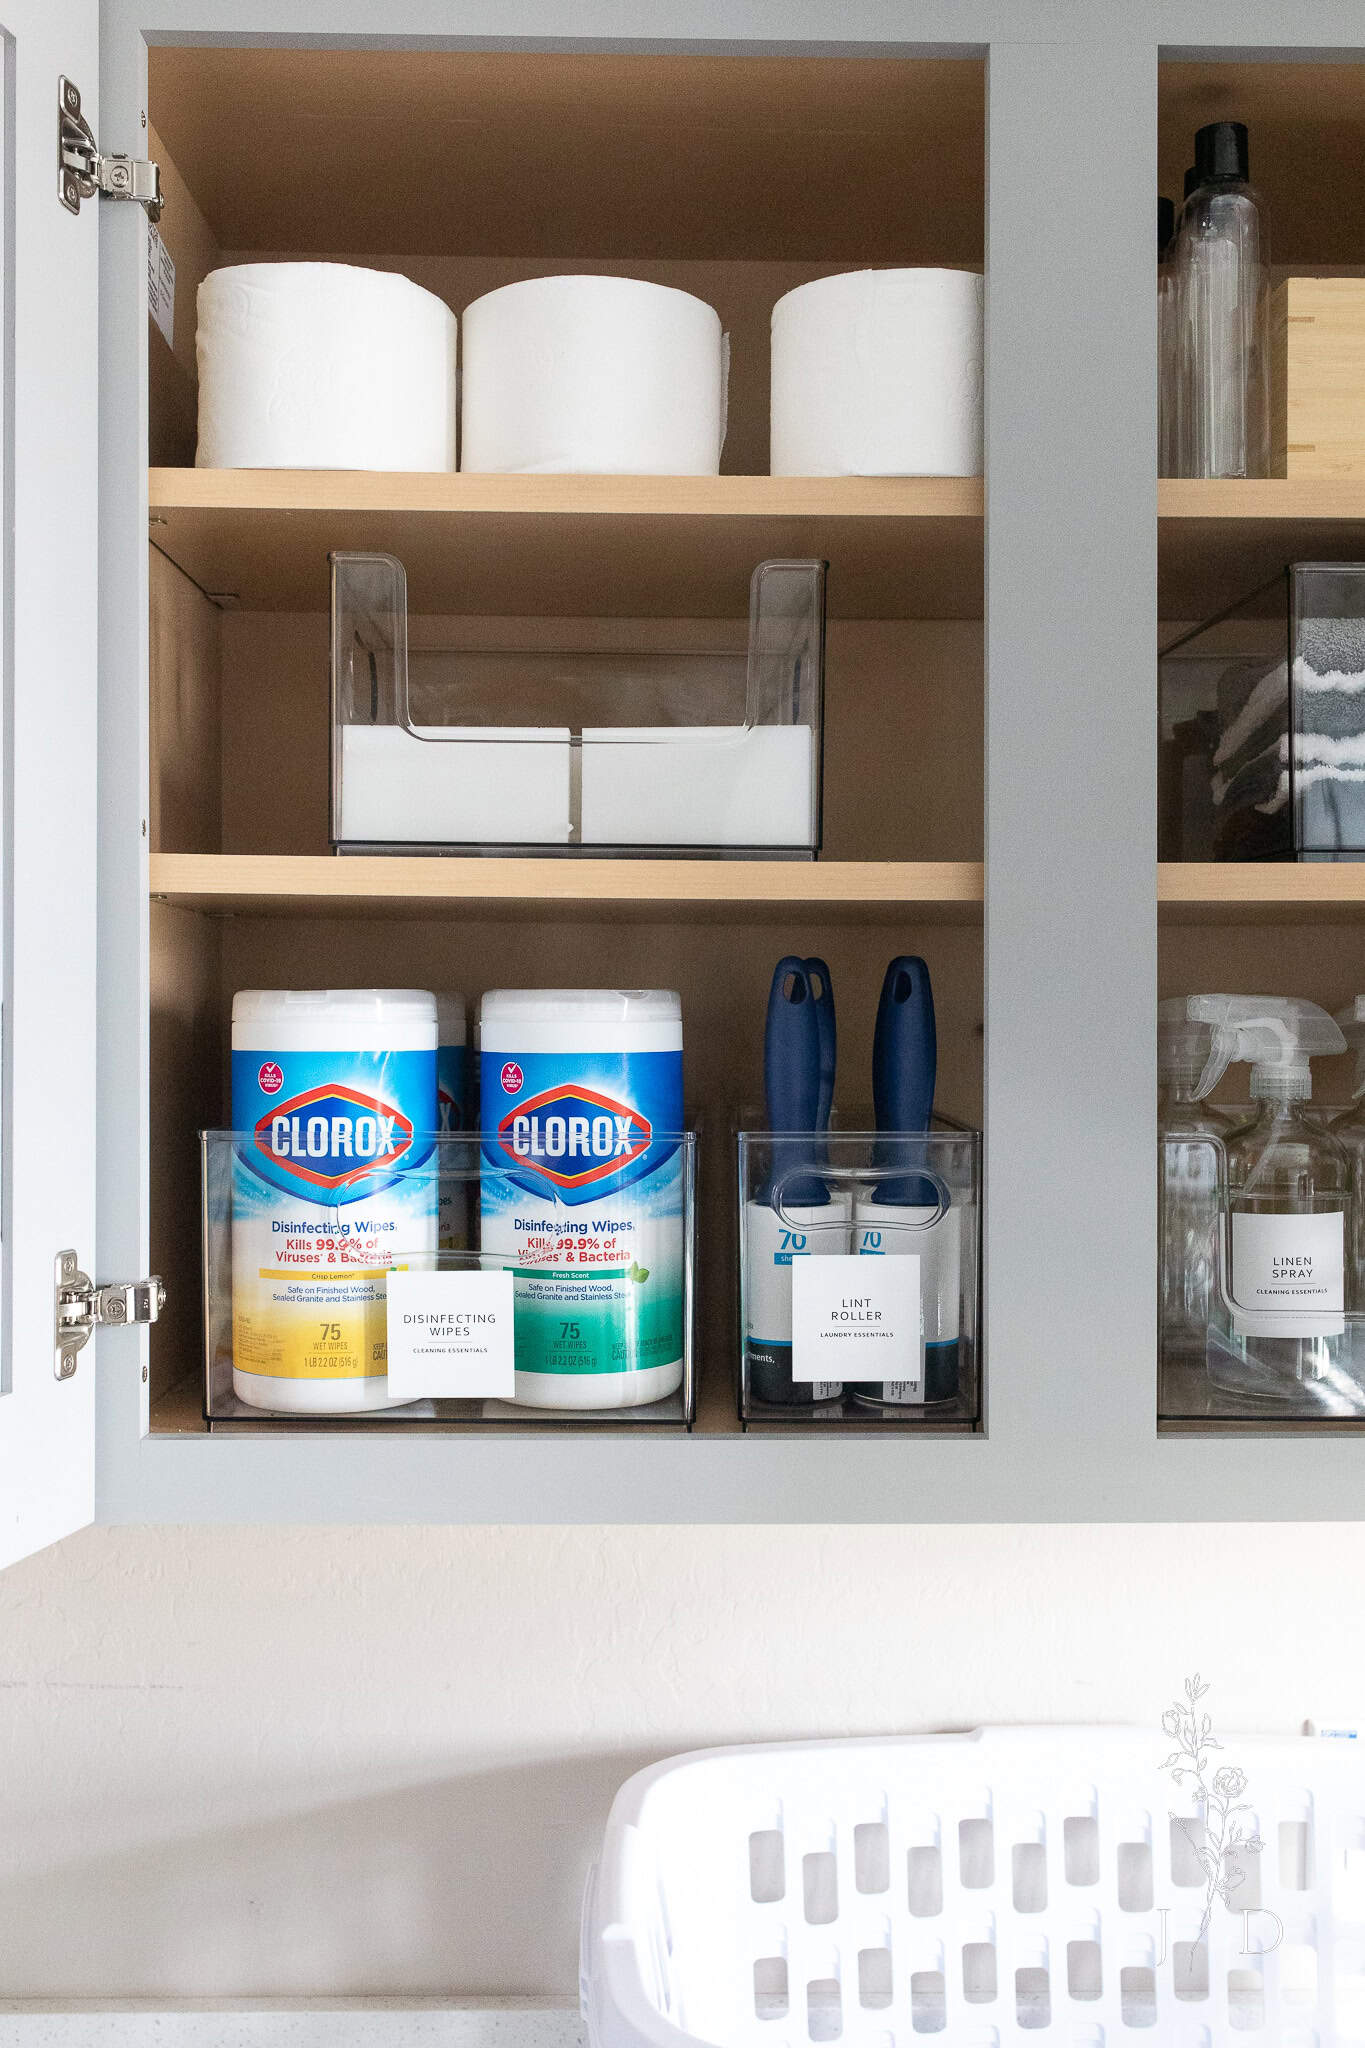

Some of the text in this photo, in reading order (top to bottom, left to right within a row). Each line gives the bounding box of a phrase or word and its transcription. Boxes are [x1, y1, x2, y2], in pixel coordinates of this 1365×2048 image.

[271, 1115, 396, 1158] CLOROX
[513, 1115, 633, 1157] CLOROX
[556, 1238, 600, 1250] 99.9%
[603, 1238, 617, 1249] of
[778, 1228, 807, 1250] 70
[862, 1231, 882, 1248] 70
[286, 1238, 379, 1251] Kills 99.9% of
[327, 1252, 337, 1263] &
[565, 1251, 575, 1262] &
[579, 1250, 631, 1263] Bacteria
[1272, 1256, 1313, 1266] LINEN
[552, 1271, 590, 1279] Fresh Scent
[1272, 1269, 1314, 1279] SPRAY
[287, 1286, 303, 1294] Safe
[316, 1286, 349, 1294] Finished
[528, 1283, 544, 1291] Safe
[555, 1284, 587, 1293] Finished
[272, 1293, 296, 1302] Sealed
[296, 1294, 325, 1303] Granite
[325, 1294, 341, 1303] and
[342, 1293, 375, 1302] Stainless
[514, 1290, 536, 1299] Sealed
[536, 1292, 563, 1301] Granite
[564, 1292, 579, 1301] and
[580, 1292, 613, 1301] Stainless
[842, 1298, 872, 1308] LINT
[403, 1314, 497, 1324] DISINFECTING
[831, 1311, 882, 1321] ROLLER
[319, 1323, 342, 1341] 75
[429, 1326, 470, 1336] WIPES
[559, 1322, 581, 1340] 75
[313, 1341, 348, 1350] WET WIPES
[552, 1340, 587, 1349] WET WIPES
